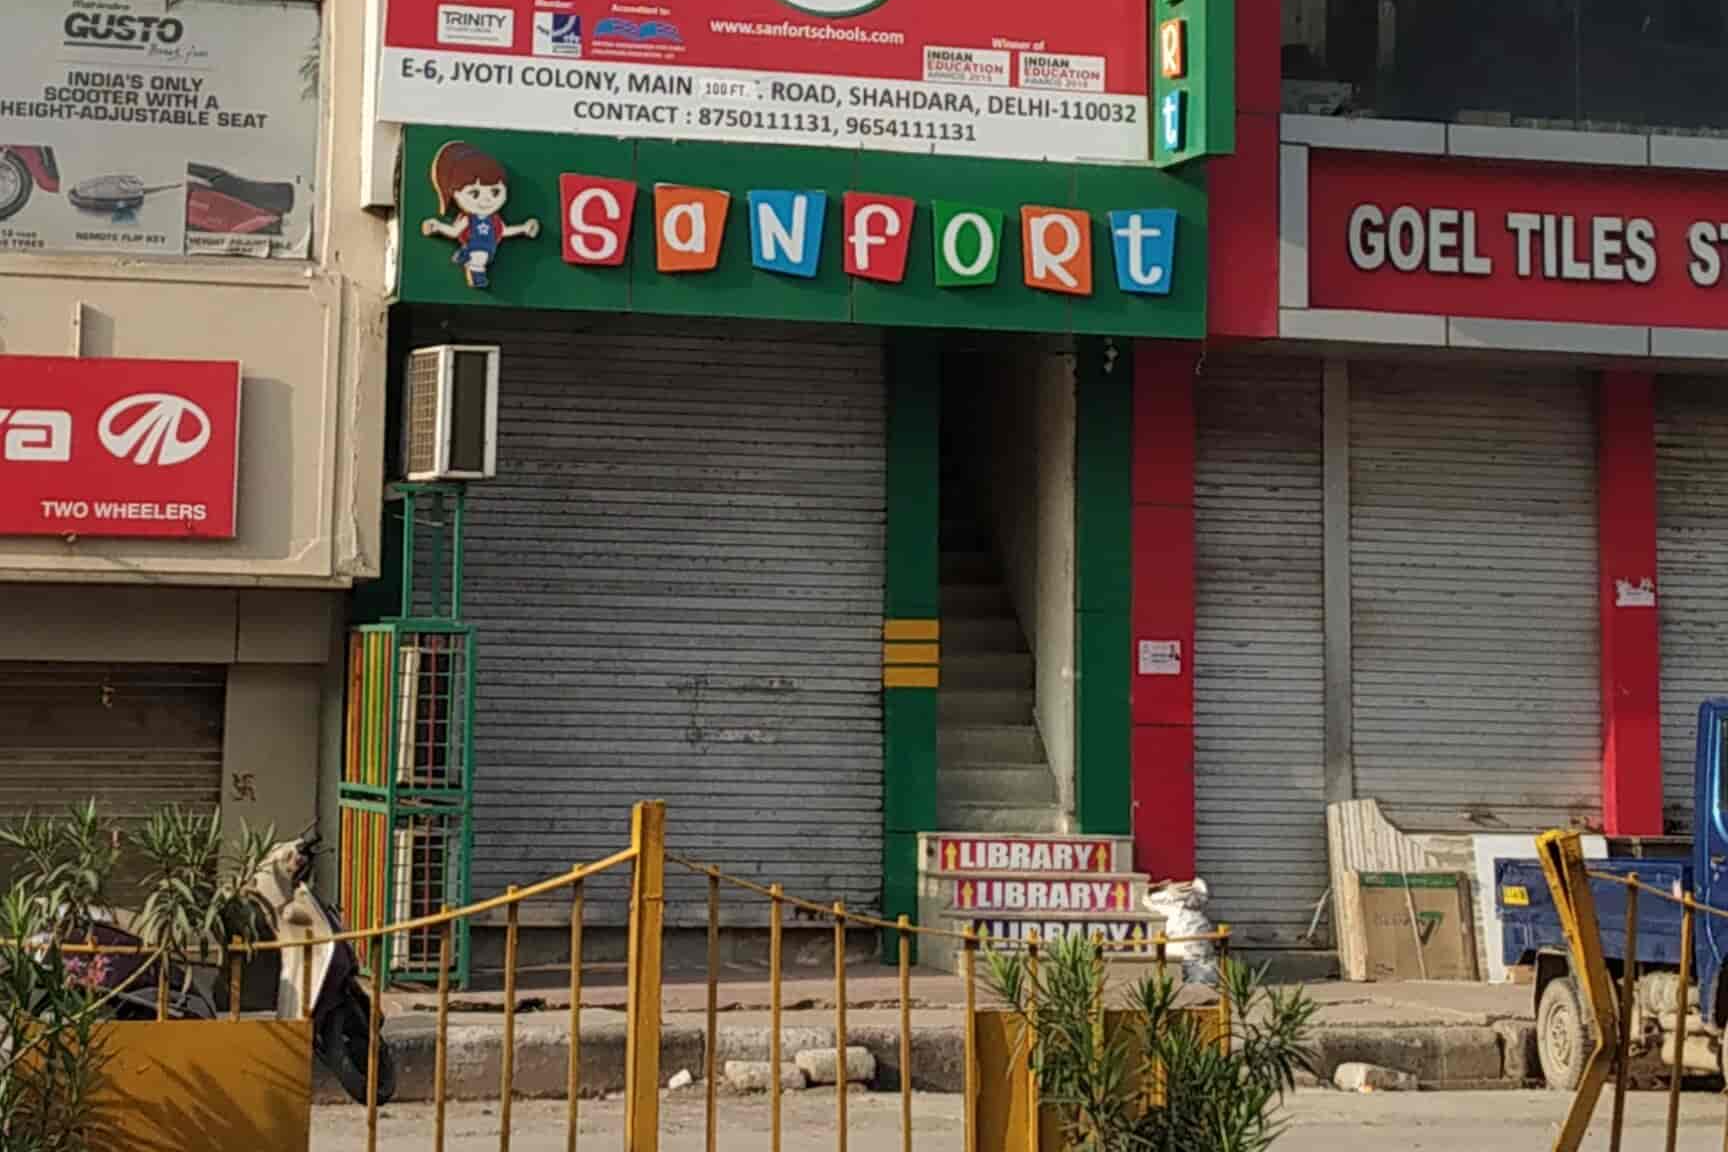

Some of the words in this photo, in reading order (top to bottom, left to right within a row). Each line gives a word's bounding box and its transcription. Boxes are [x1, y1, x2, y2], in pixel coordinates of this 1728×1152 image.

[63, 11, 184, 44] GUSTO
[441, 10, 507, 29] TRINITY
[709, 19, 905, 45] www.sanfortschools.com
[927, 50, 973, 63] INDIAN
[927, 61, 1004, 75] EDUCATION
[1024, 56, 1070, 68] INDIAN
[68, 71, 144, 90] INDIA'S
[151, 75, 203, 93] ONLY
[1024, 67, 1101, 81] EDUCATION
[44, 86, 140, 106] SCOOTER
[145, 91, 199, 109] WITH
[205, 95, 219, 110] A
[401, 57, 444, 84] E-6,
[450, 60, 513, 86] JYOTI
[520, 66, 620, 94] COLONY,
[627, 73, 693, 96] MAIN
[771, 81, 843, 108] ROAD,
[850, 86, 981, 116] SHAHDARA,
[987, 95, 1137, 124] DELHI-110032
[1, 101, 210, 127] HEIGHT-ADJUSTABLE
[217, 111, 268, 130] SEAT
[574, 100, 678, 125] CONTACT
[698, 107, 840, 136] 8750111131,
[845, 116, 977, 142] 9654111131
[1349, 204, 1493, 276] GOEL
[1507, 212, 1657, 283] TILES
[1688, 221, 1728, 286] S
[41, 500, 89, 519] TWO
[94, 503, 207, 521] WHEELERS
[959, 841, 1095, 871] LIBRARY
[975, 881, 1113, 910] LIBRARY
